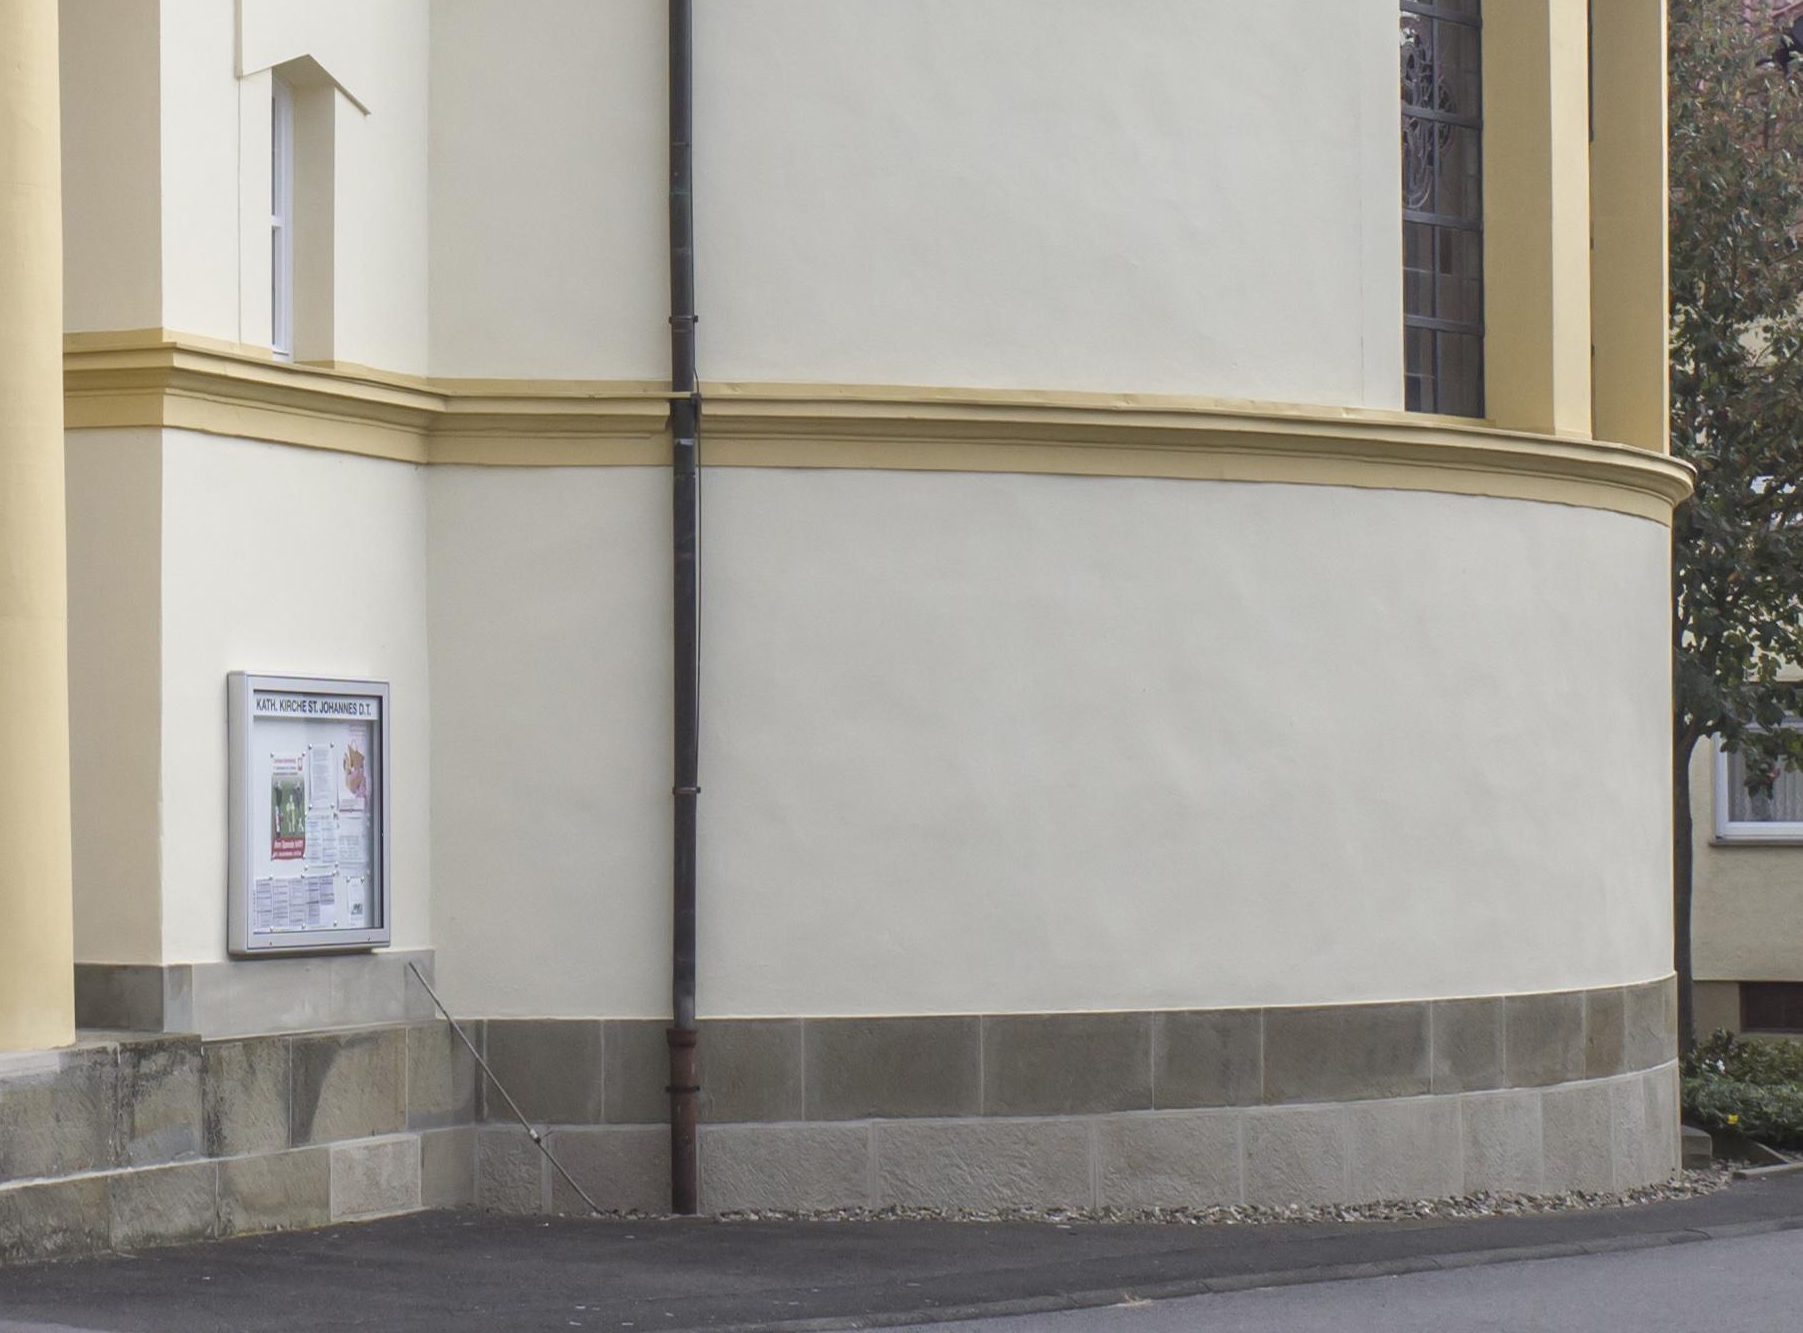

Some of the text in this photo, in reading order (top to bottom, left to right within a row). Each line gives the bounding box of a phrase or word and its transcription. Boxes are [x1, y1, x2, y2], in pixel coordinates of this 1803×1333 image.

[256, 698, 277, 711] KATH.
[279, 699, 307, 713] KIRCHE
[307, 700, 318, 713] ST.
[319, 700, 357, 715] JOHANNES
